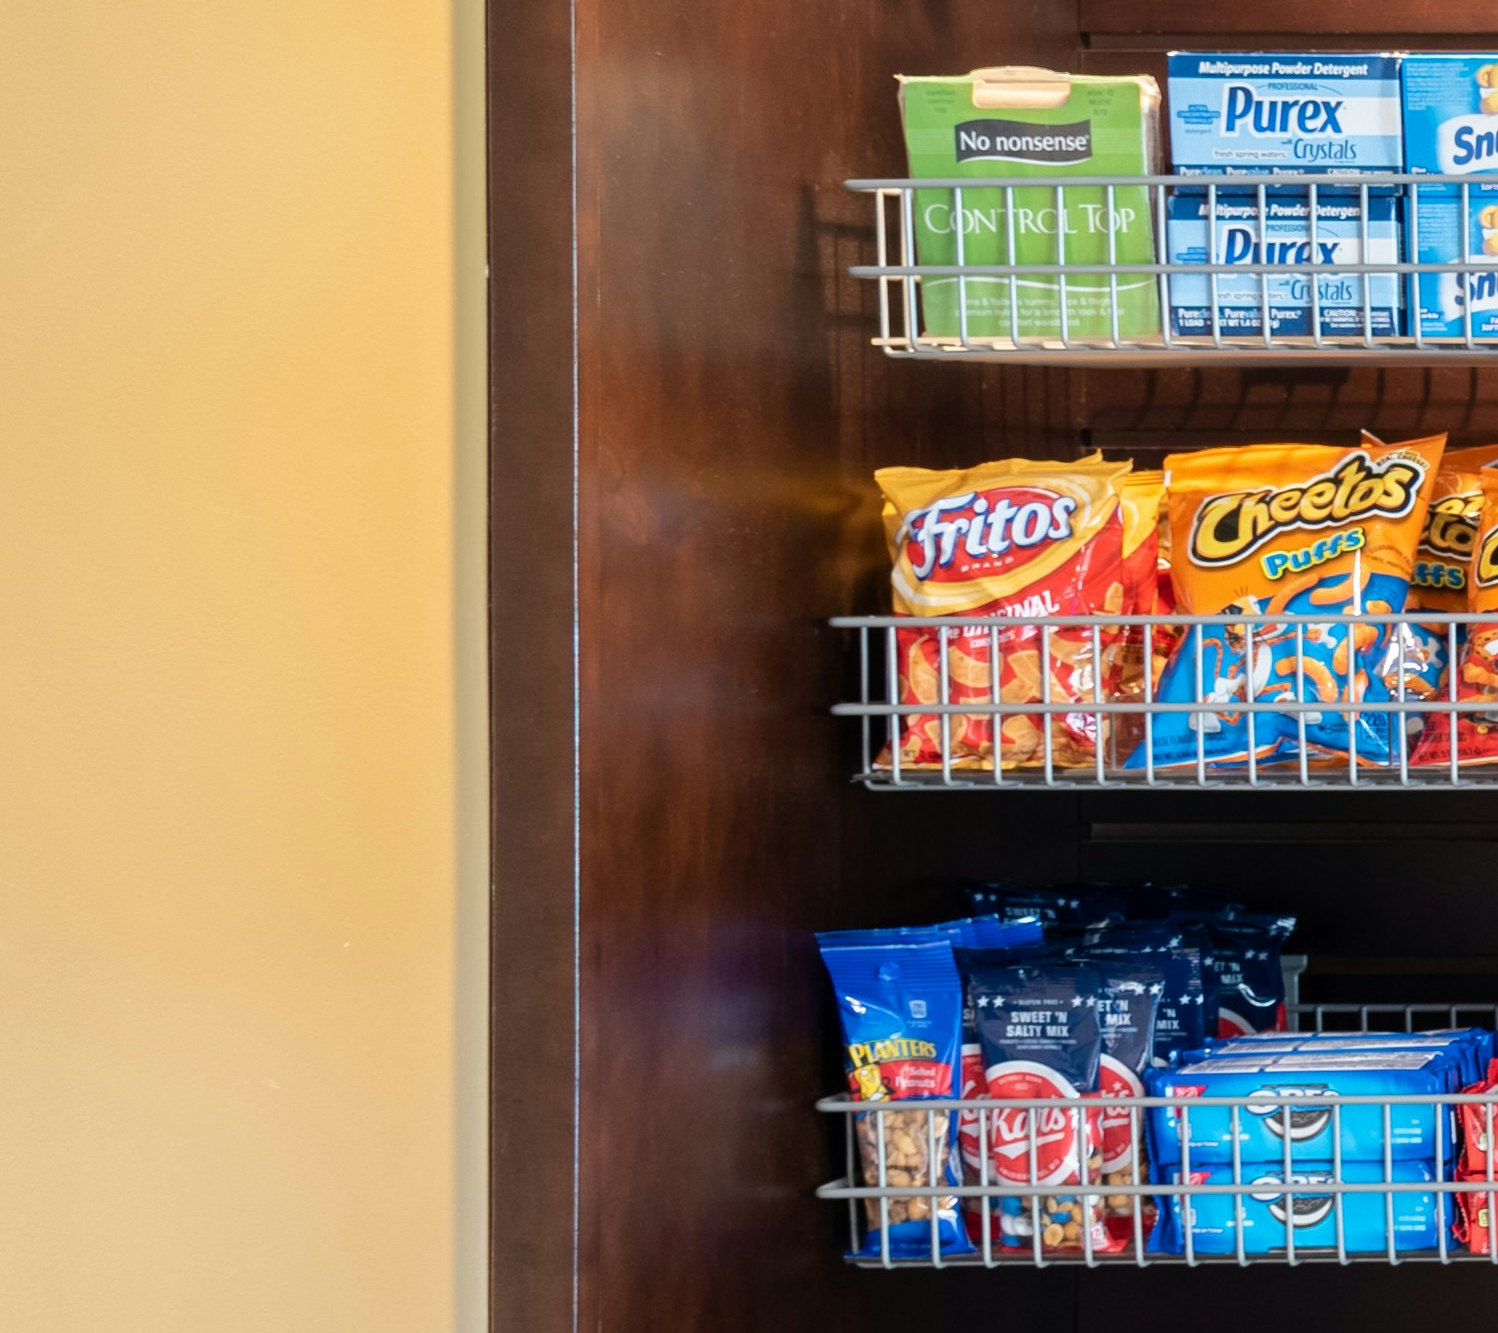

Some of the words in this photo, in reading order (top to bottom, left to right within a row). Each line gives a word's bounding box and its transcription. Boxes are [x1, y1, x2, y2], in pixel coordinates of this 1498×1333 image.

[1199, 62, 1268, 77] Multipurpose
[1271, 62, 1311, 75] Powder
[1315, 63, 1368, 77] Detergent
[1226, 87, 1343, 134] Purex
[959, 132, 992, 151] No
[996, 133, 1088, 153] nonsense
[1293, 139, 1357, 163] Crystals
[1079, 204, 1135, 233] TOP
[1194, 458, 1423, 562] Cheetos
[912, 492, 1078, 579] Fritos
[961, 555, 1014, 573] BRAND
[1261, 527, 1366, 579] Puffs
[1011, 1012, 1051, 1023] SWEET
[1007, 1025, 1041, 1037] SALTY
[1047, 1026, 1069, 1037] MIX
[849, 1040, 936, 1066] PLANTERS
